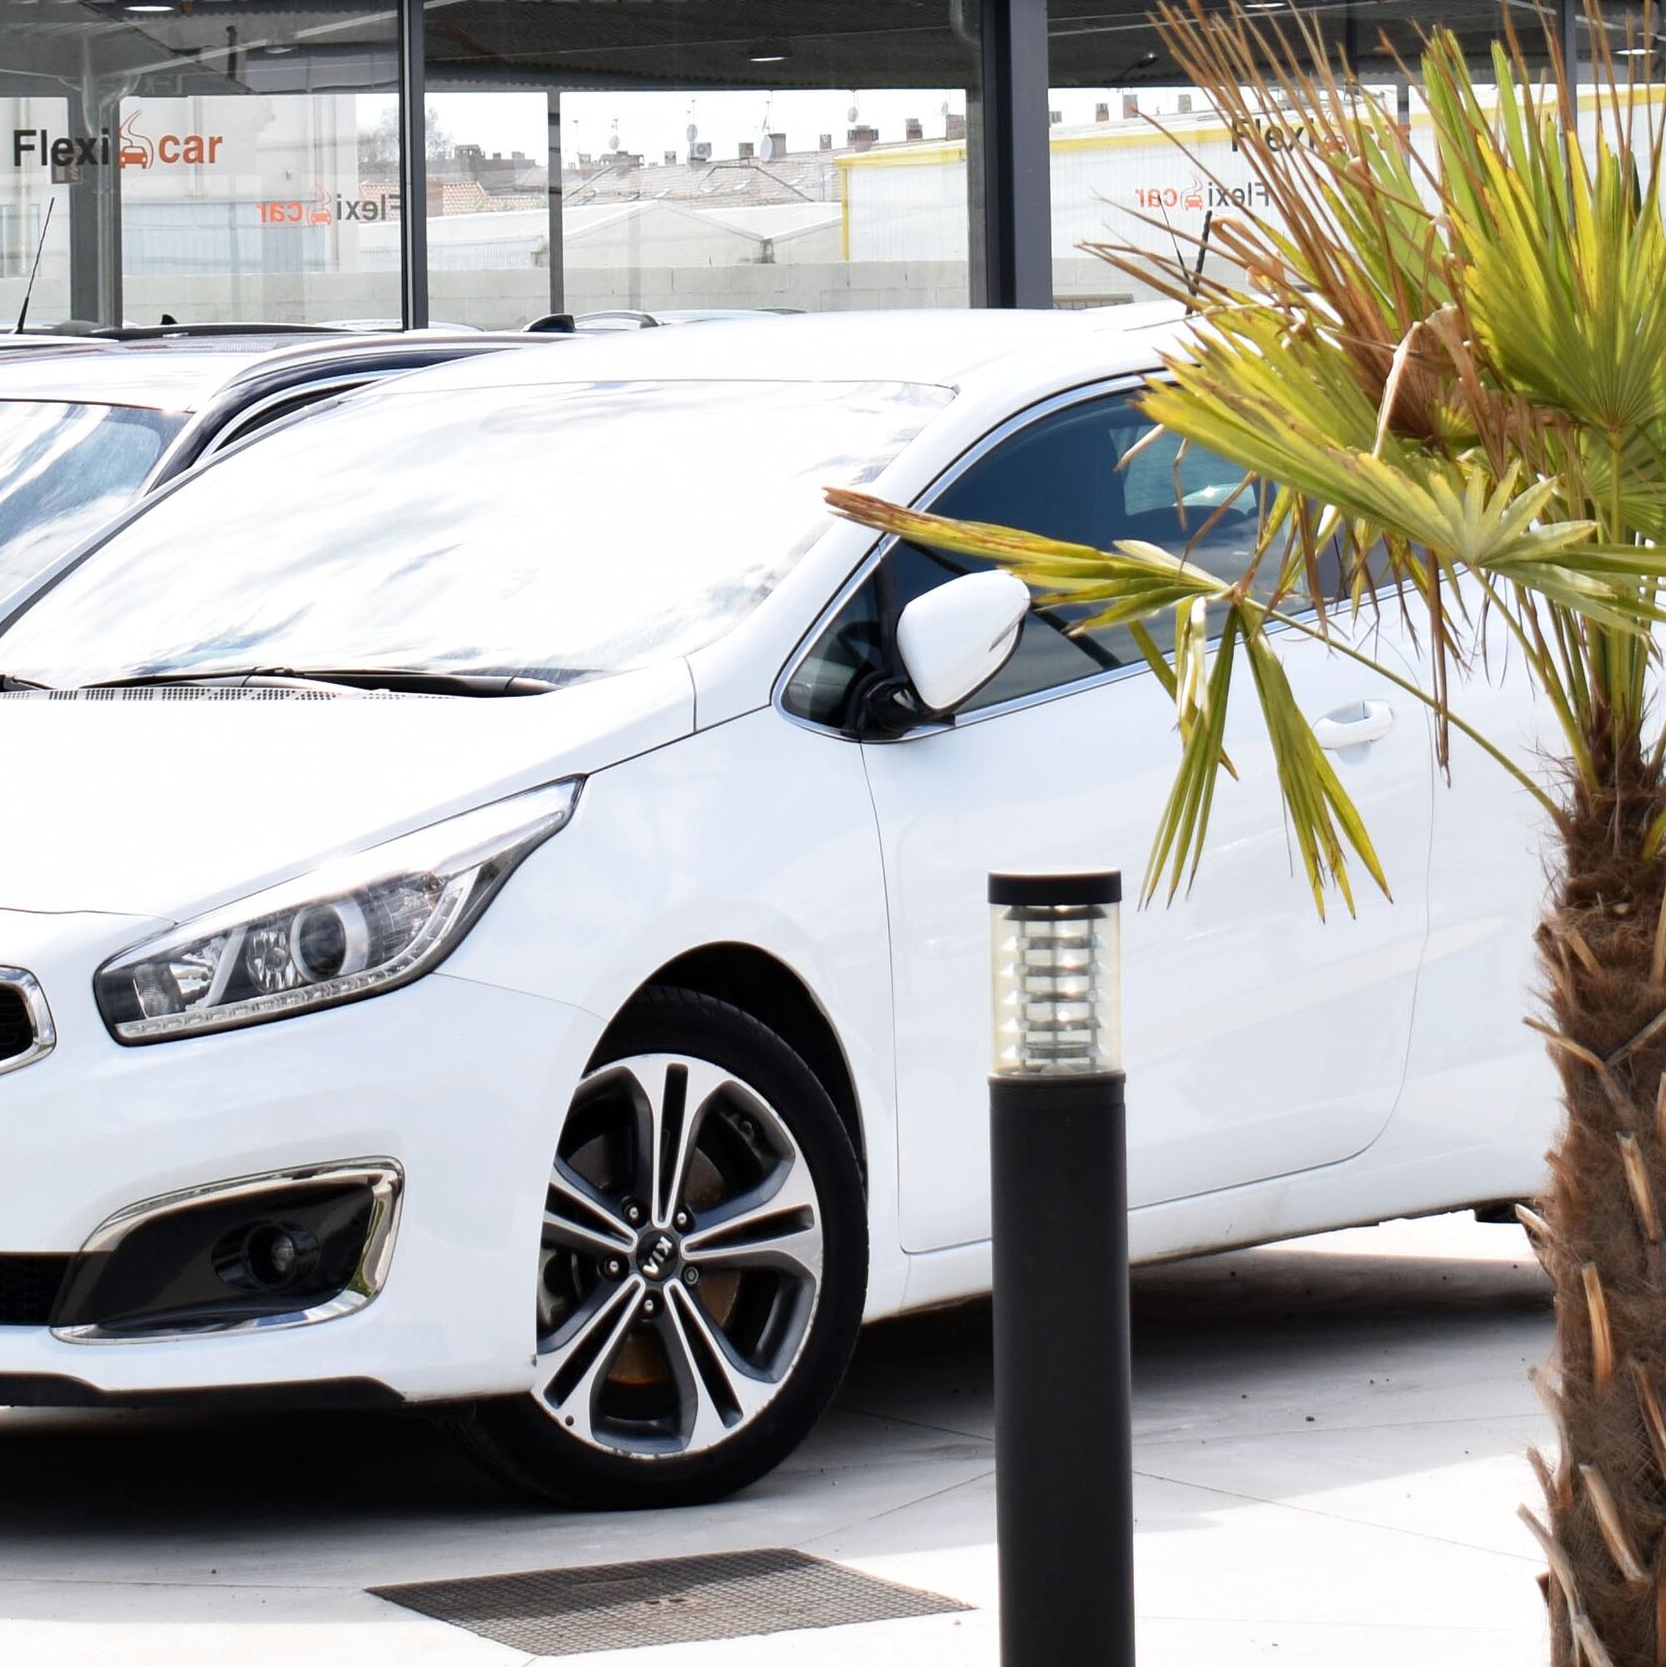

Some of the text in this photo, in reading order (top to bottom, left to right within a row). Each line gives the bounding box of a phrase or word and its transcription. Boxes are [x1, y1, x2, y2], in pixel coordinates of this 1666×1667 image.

[14, 127, 223, 167] Flexi car
[643, 1236, 672, 1274] KIA
